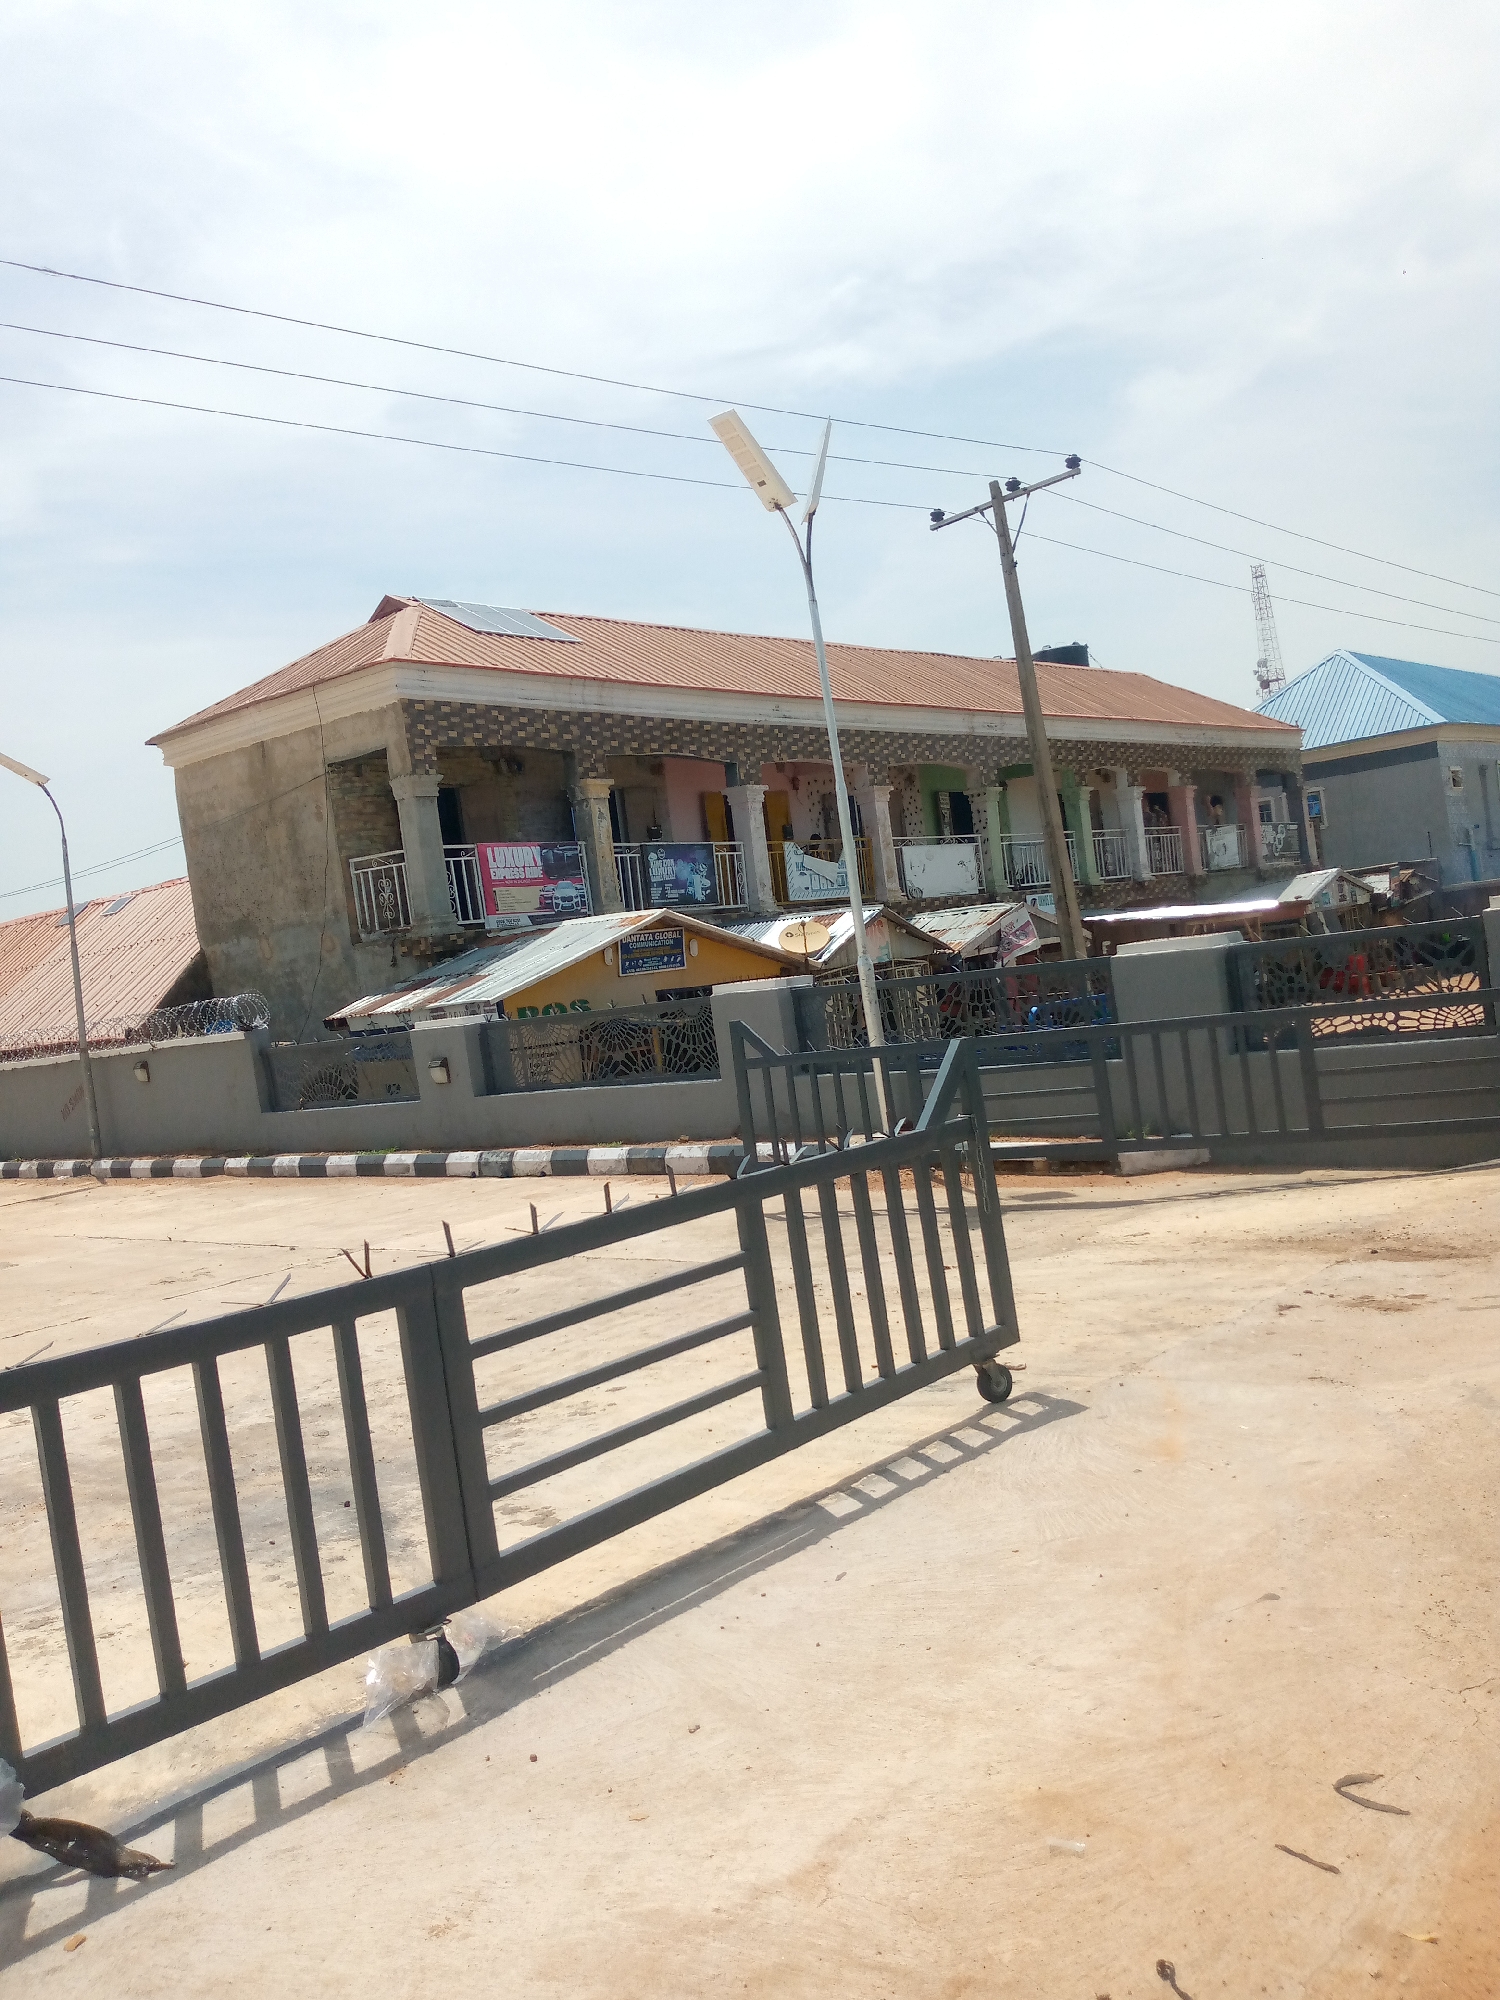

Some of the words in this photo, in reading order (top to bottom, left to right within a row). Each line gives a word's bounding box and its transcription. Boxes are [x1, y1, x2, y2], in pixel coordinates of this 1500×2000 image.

[487, 846, 543, 868] LUXURY
[490, 867, 525, 880] EXPRESS
[655, 931, 681, 940] GLOBAL
[629, 939, 674, 949] COMMUNICATION
